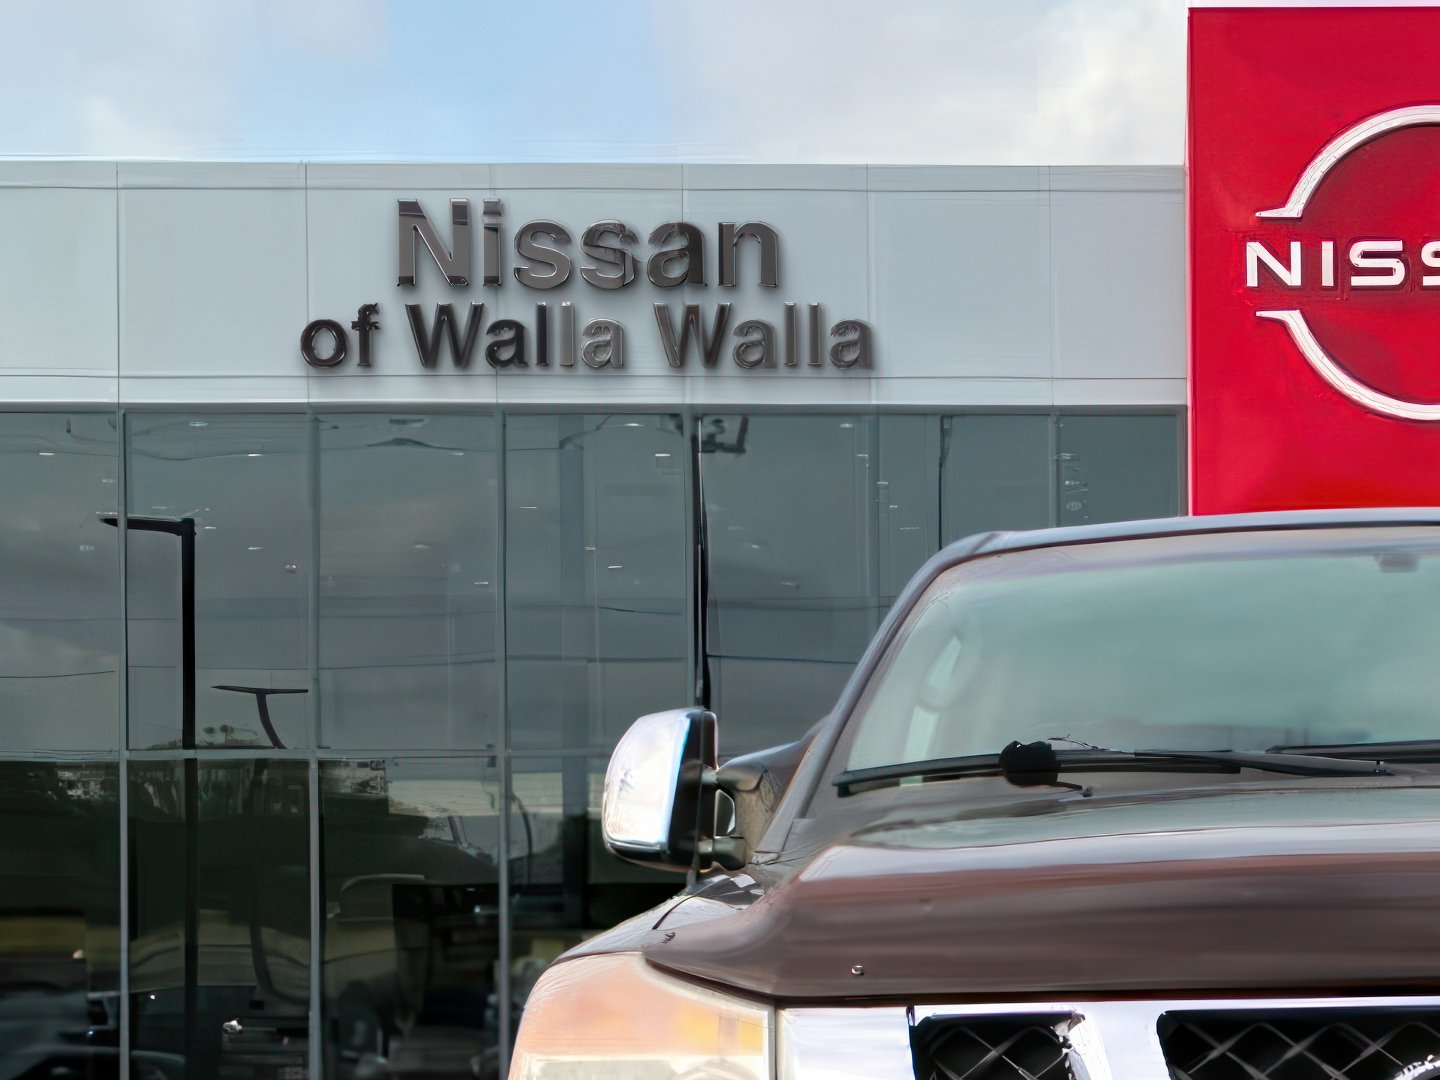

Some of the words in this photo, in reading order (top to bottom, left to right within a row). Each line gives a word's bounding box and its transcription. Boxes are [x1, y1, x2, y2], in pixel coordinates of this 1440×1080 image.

[397, 197, 780, 288] Nissan
[299, 302, 382, 370] of
[404, 301, 625, 370] Walla
[652, 301, 875, 370] Walla
